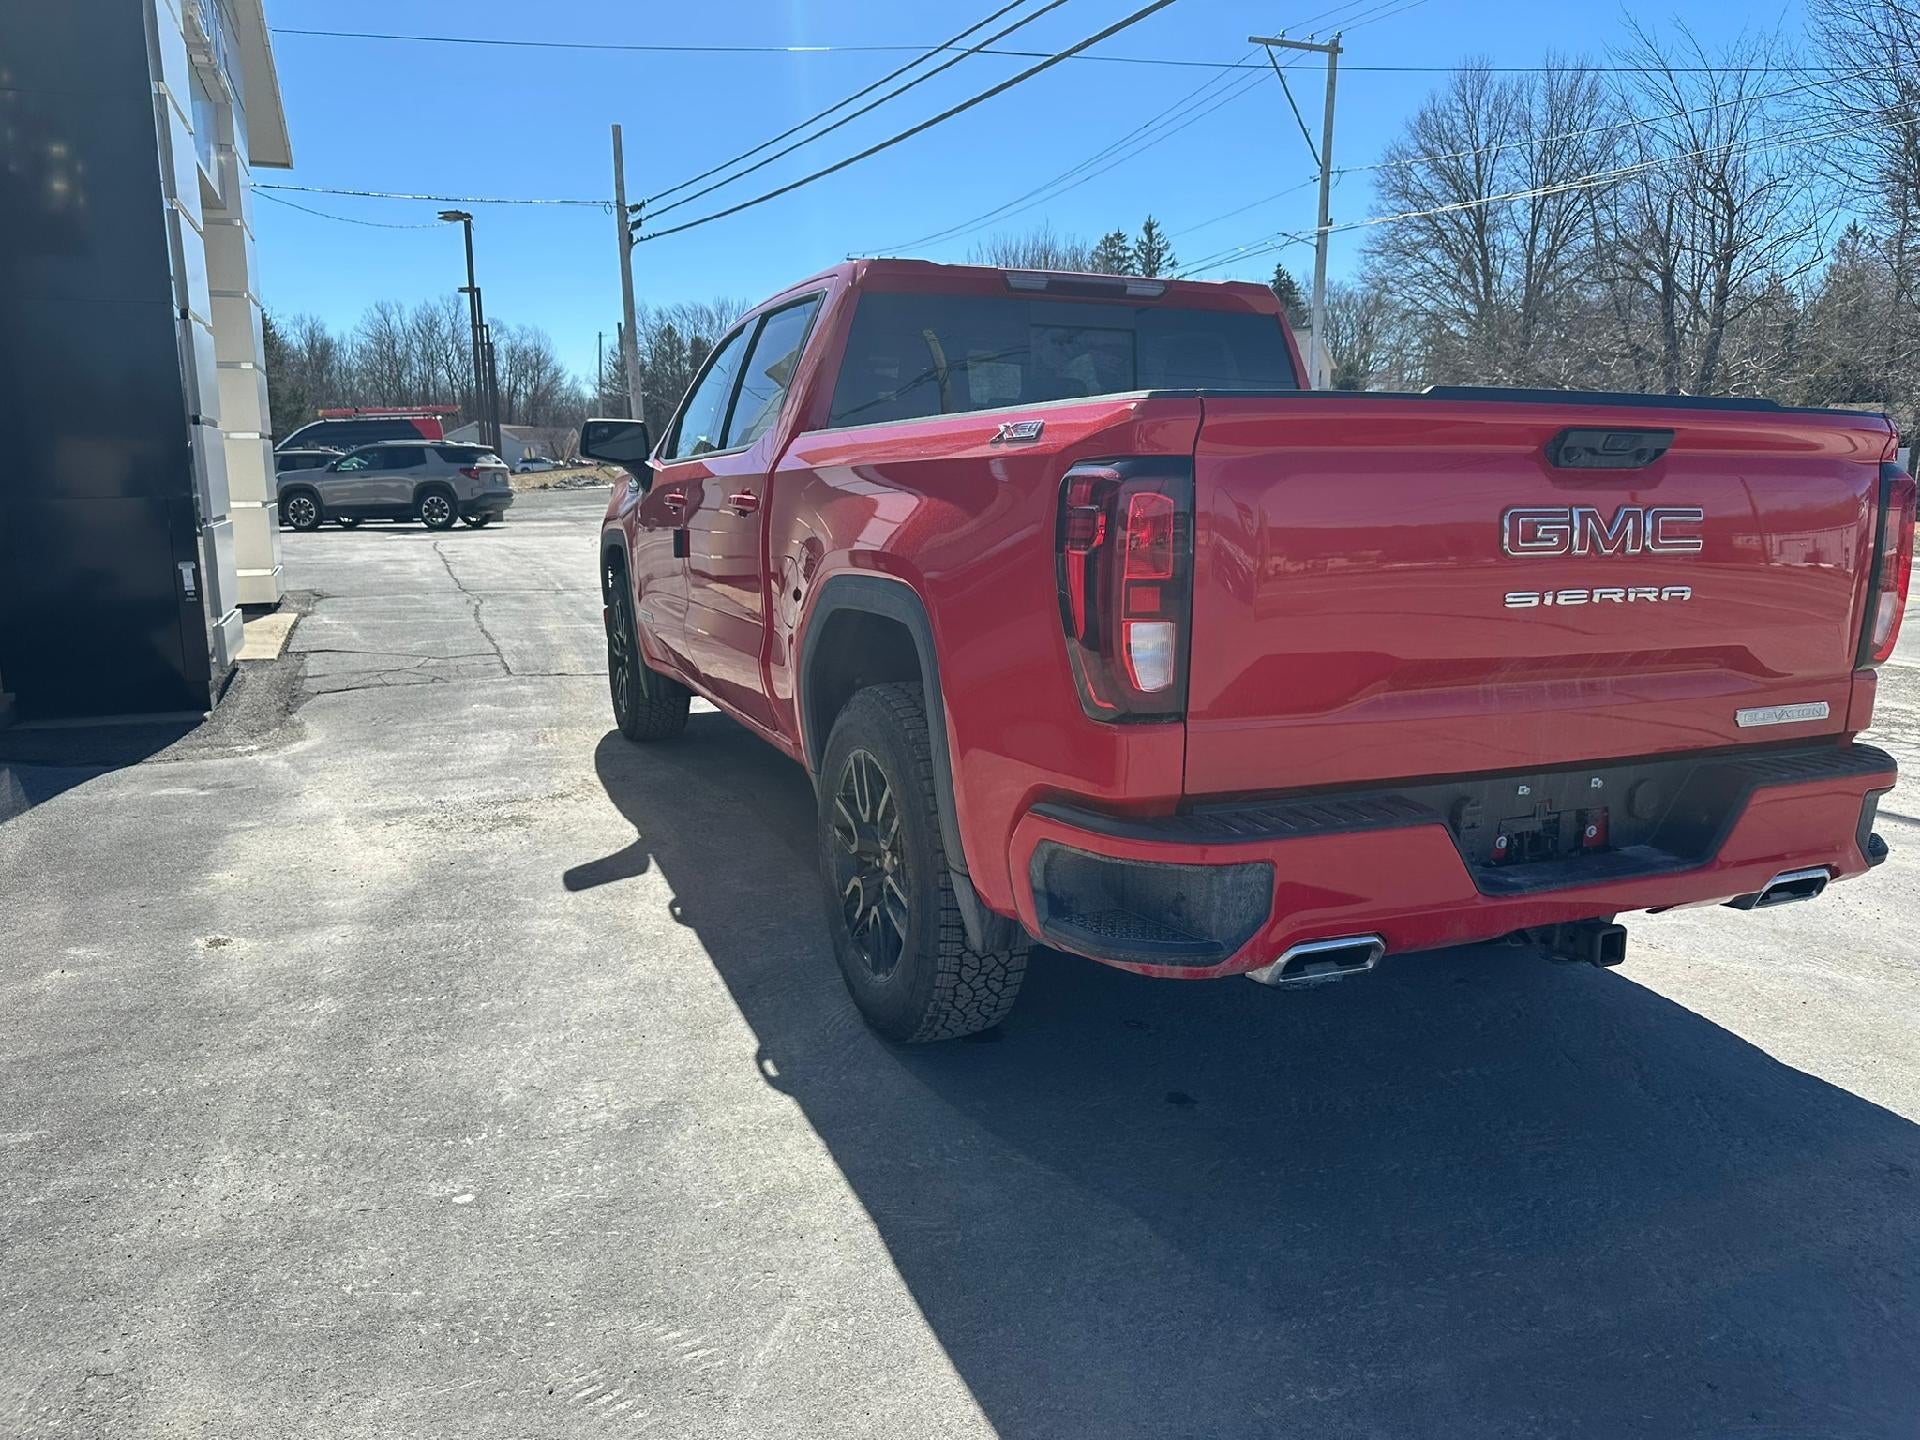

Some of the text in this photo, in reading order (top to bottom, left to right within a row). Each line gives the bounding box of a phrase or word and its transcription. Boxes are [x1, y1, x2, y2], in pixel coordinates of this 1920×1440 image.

[1502, 506, 1704, 557] GMC
[1504, 586, 1692, 608] SIERRA
[1742, 703, 1827, 723] ELEVATION
